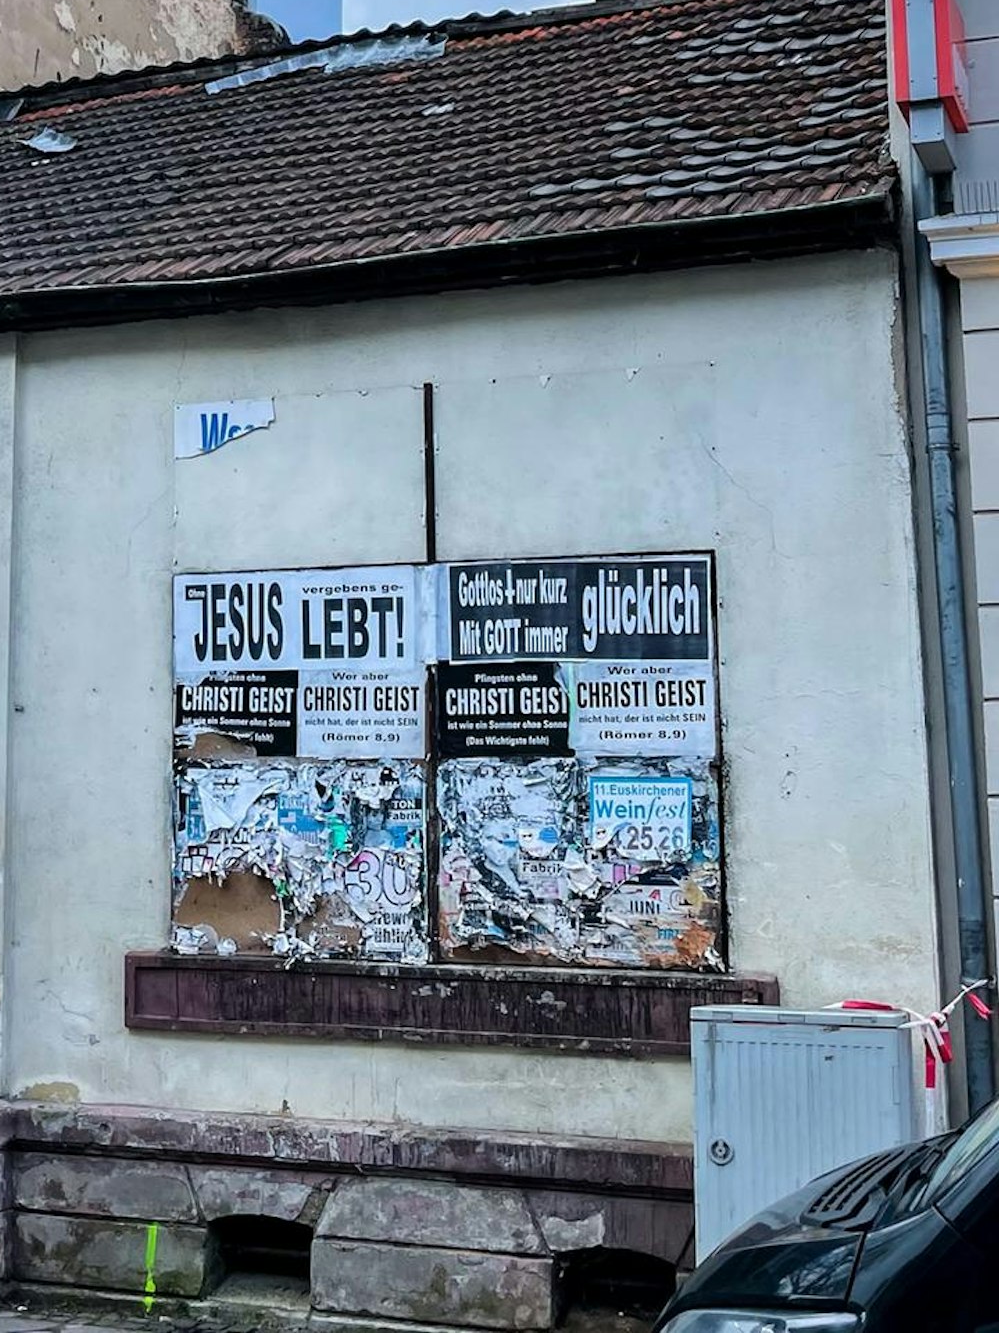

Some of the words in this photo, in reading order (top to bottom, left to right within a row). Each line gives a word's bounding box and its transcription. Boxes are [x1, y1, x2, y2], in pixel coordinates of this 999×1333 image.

[302, 585, 376, 595] vergebens
[459, 571, 504, 607] Gottlos
[516, 578, 537, 605] nur
[539, 570, 567, 604] kurz
[186, 582, 283, 662] JESUS
[582, 568, 700, 653] glücklich
[302, 597, 404, 659] LEBT!
[459, 620, 481, 655] Mit
[484, 618, 521, 655] GOTT
[524, 618, 568, 653] immer
[332, 672, 357, 681] Wer
[361, 672, 389, 681] aber
[474, 673, 514, 684] Pfingsten
[516, 673, 538, 683] ohne
[607, 666, 637, 675] Wer
[641, 666, 673, 675] aber
[182, 687, 243, 711] CHRISTI
[249, 687, 294, 713] GEIST
[304, 686, 366, 711] CHRISTI
[374, 686, 419, 711] GEIST
[446, 688, 514, 716] CHRISTI
[520, 687, 567, 715] GEIST
[577, 681, 648, 708] CHRISTI
[655, 680, 706, 707] GEIST
[305, 717, 325, 726] nicht
[345, 717, 359, 726] der
[361, 717, 371, 725] ist
[374, 717, 394, 726] nicht
[397, 717, 418, 727] SEIN
[488, 719, 521, 729] Sommer
[542, 719, 568, 729] Sonne
[579, 714, 602, 723] nicht
[624, 714, 640, 723] der
[642, 713, 654, 723] ist
[656, 713, 680, 723] nicht
[682, 712, 706, 722] SEIN
[322, 732, 369, 743] (Römer
[599, 730, 653, 741] (Römer
[595, 796, 686, 825] Weinfest
